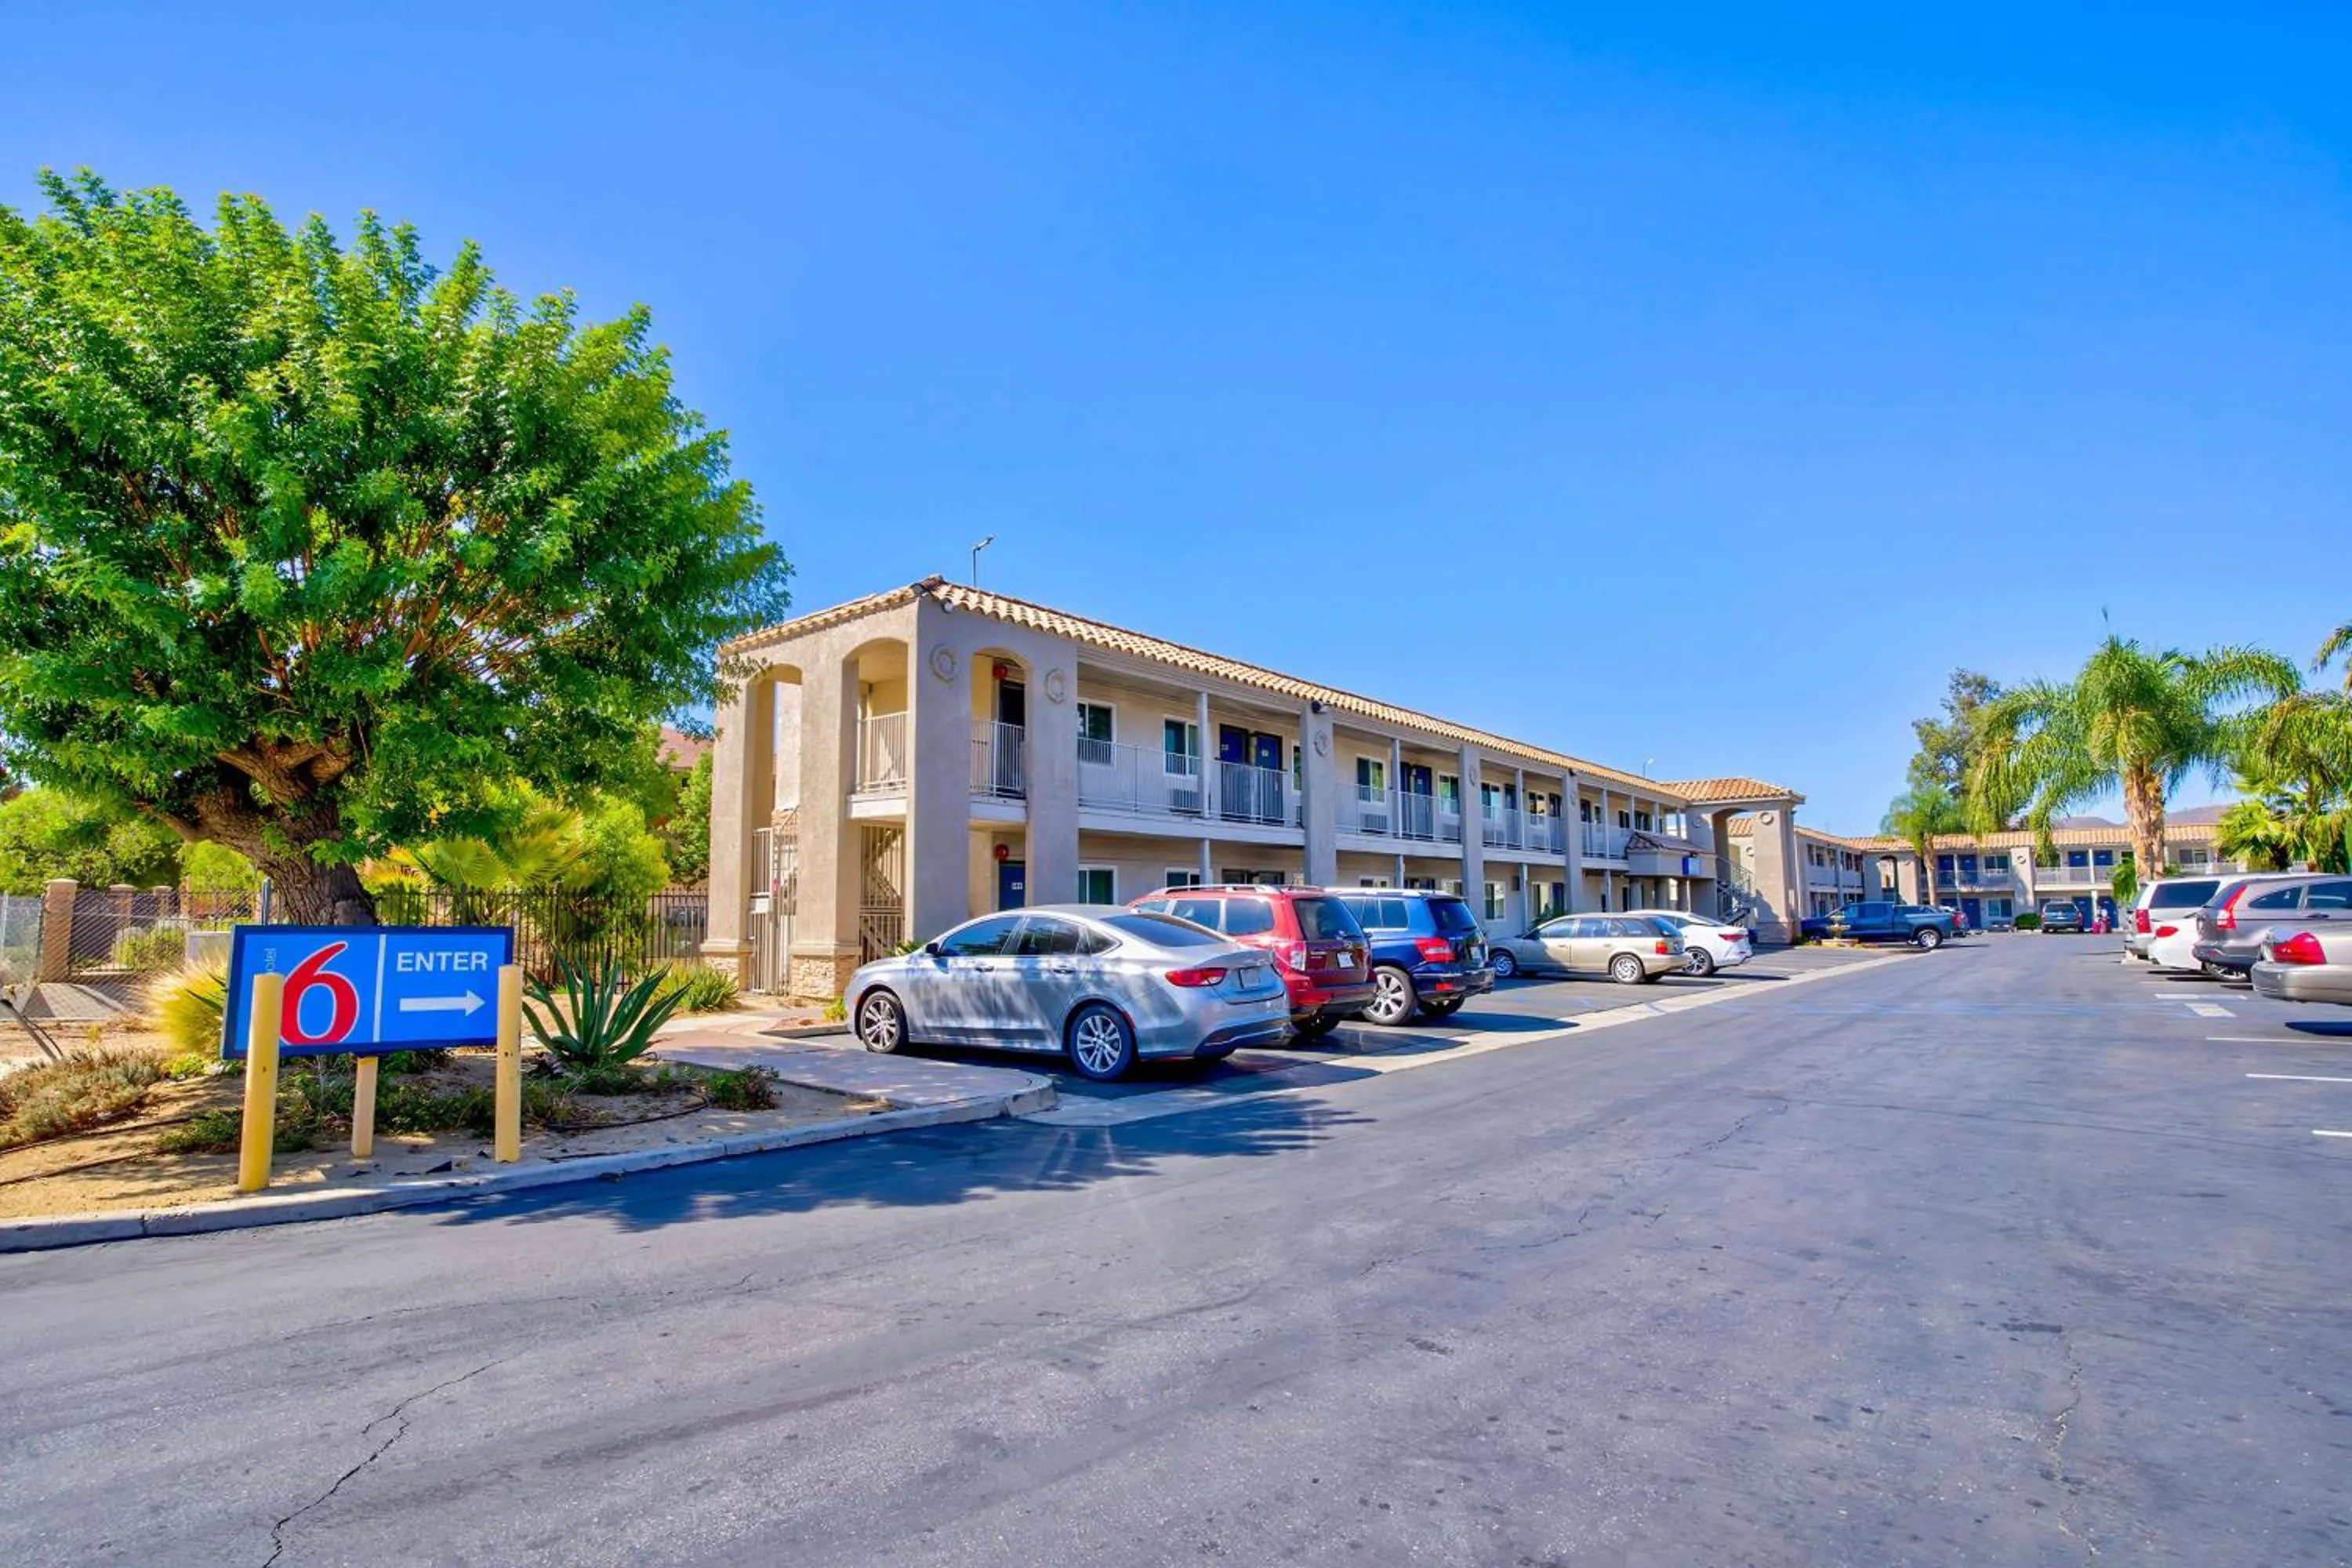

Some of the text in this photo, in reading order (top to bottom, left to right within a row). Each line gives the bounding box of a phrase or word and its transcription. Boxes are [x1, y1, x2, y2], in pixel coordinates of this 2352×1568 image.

[263, 948, 276, 972] otel
[396, 952, 488, 972] ENTER
[281, 941, 360, 1045] 6
